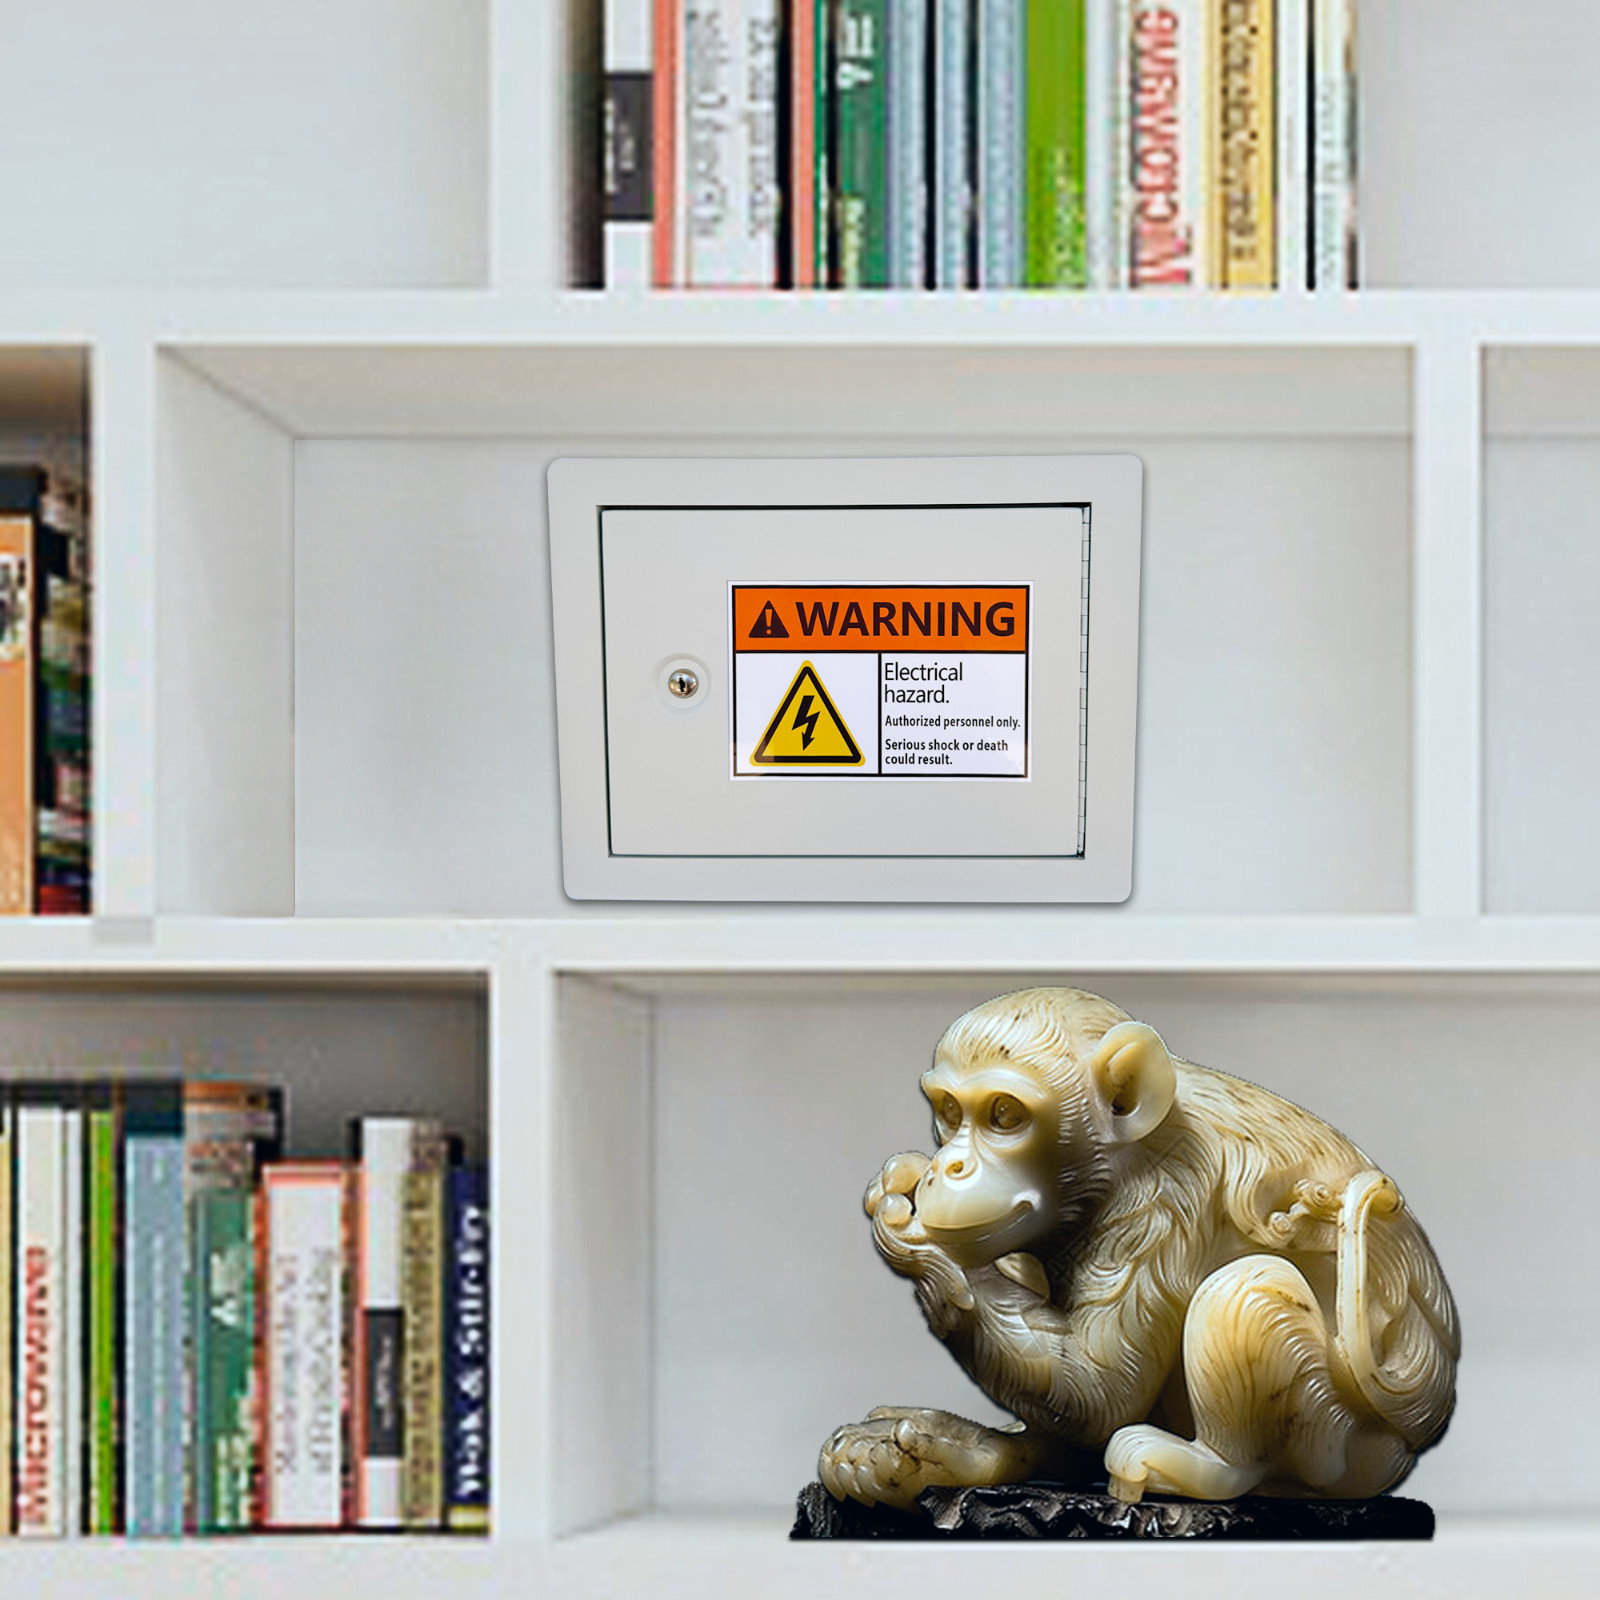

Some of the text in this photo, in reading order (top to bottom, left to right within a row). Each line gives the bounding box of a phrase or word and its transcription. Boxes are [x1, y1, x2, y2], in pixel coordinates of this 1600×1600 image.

[796, 602, 1014, 636] WARNING
[885, 662, 963, 681] Electrical
[885, 684, 949, 704] hazard.
[885, 714, 1021, 731] Authorized personnel only.
[885, 738, 1008, 751] Serious shock or death
[885, 753, 953, 765] could result.
